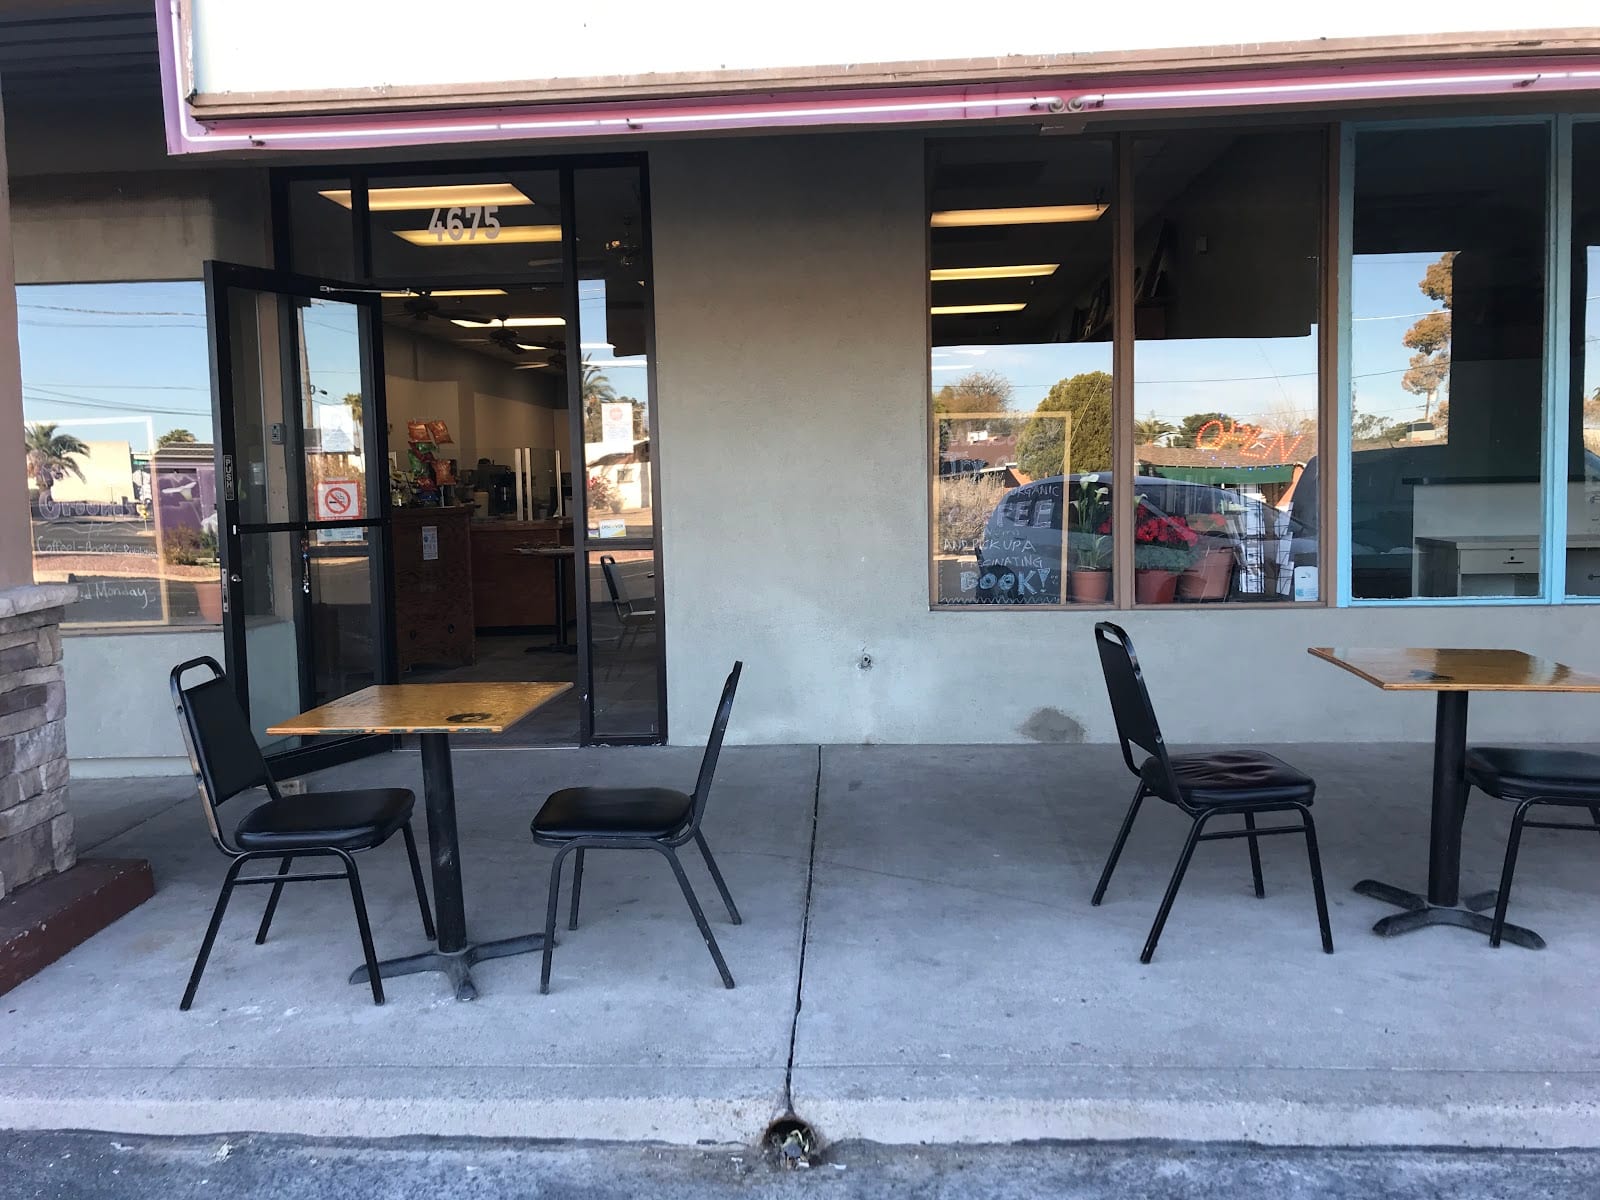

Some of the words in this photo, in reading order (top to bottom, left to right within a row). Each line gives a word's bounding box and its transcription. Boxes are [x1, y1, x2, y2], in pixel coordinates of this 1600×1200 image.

[428, 205, 500, 241] 4675
[1196, 419, 1304, 463] OPEN
[225, 459, 233, 488] PUSH
[943, 539, 968, 551] AND
[1003, 540, 1020, 552] UP
[1021, 540, 1036, 553] A
[96, 581, 148, 609] Monday
[960, 568, 1051, 596] BOOK!
